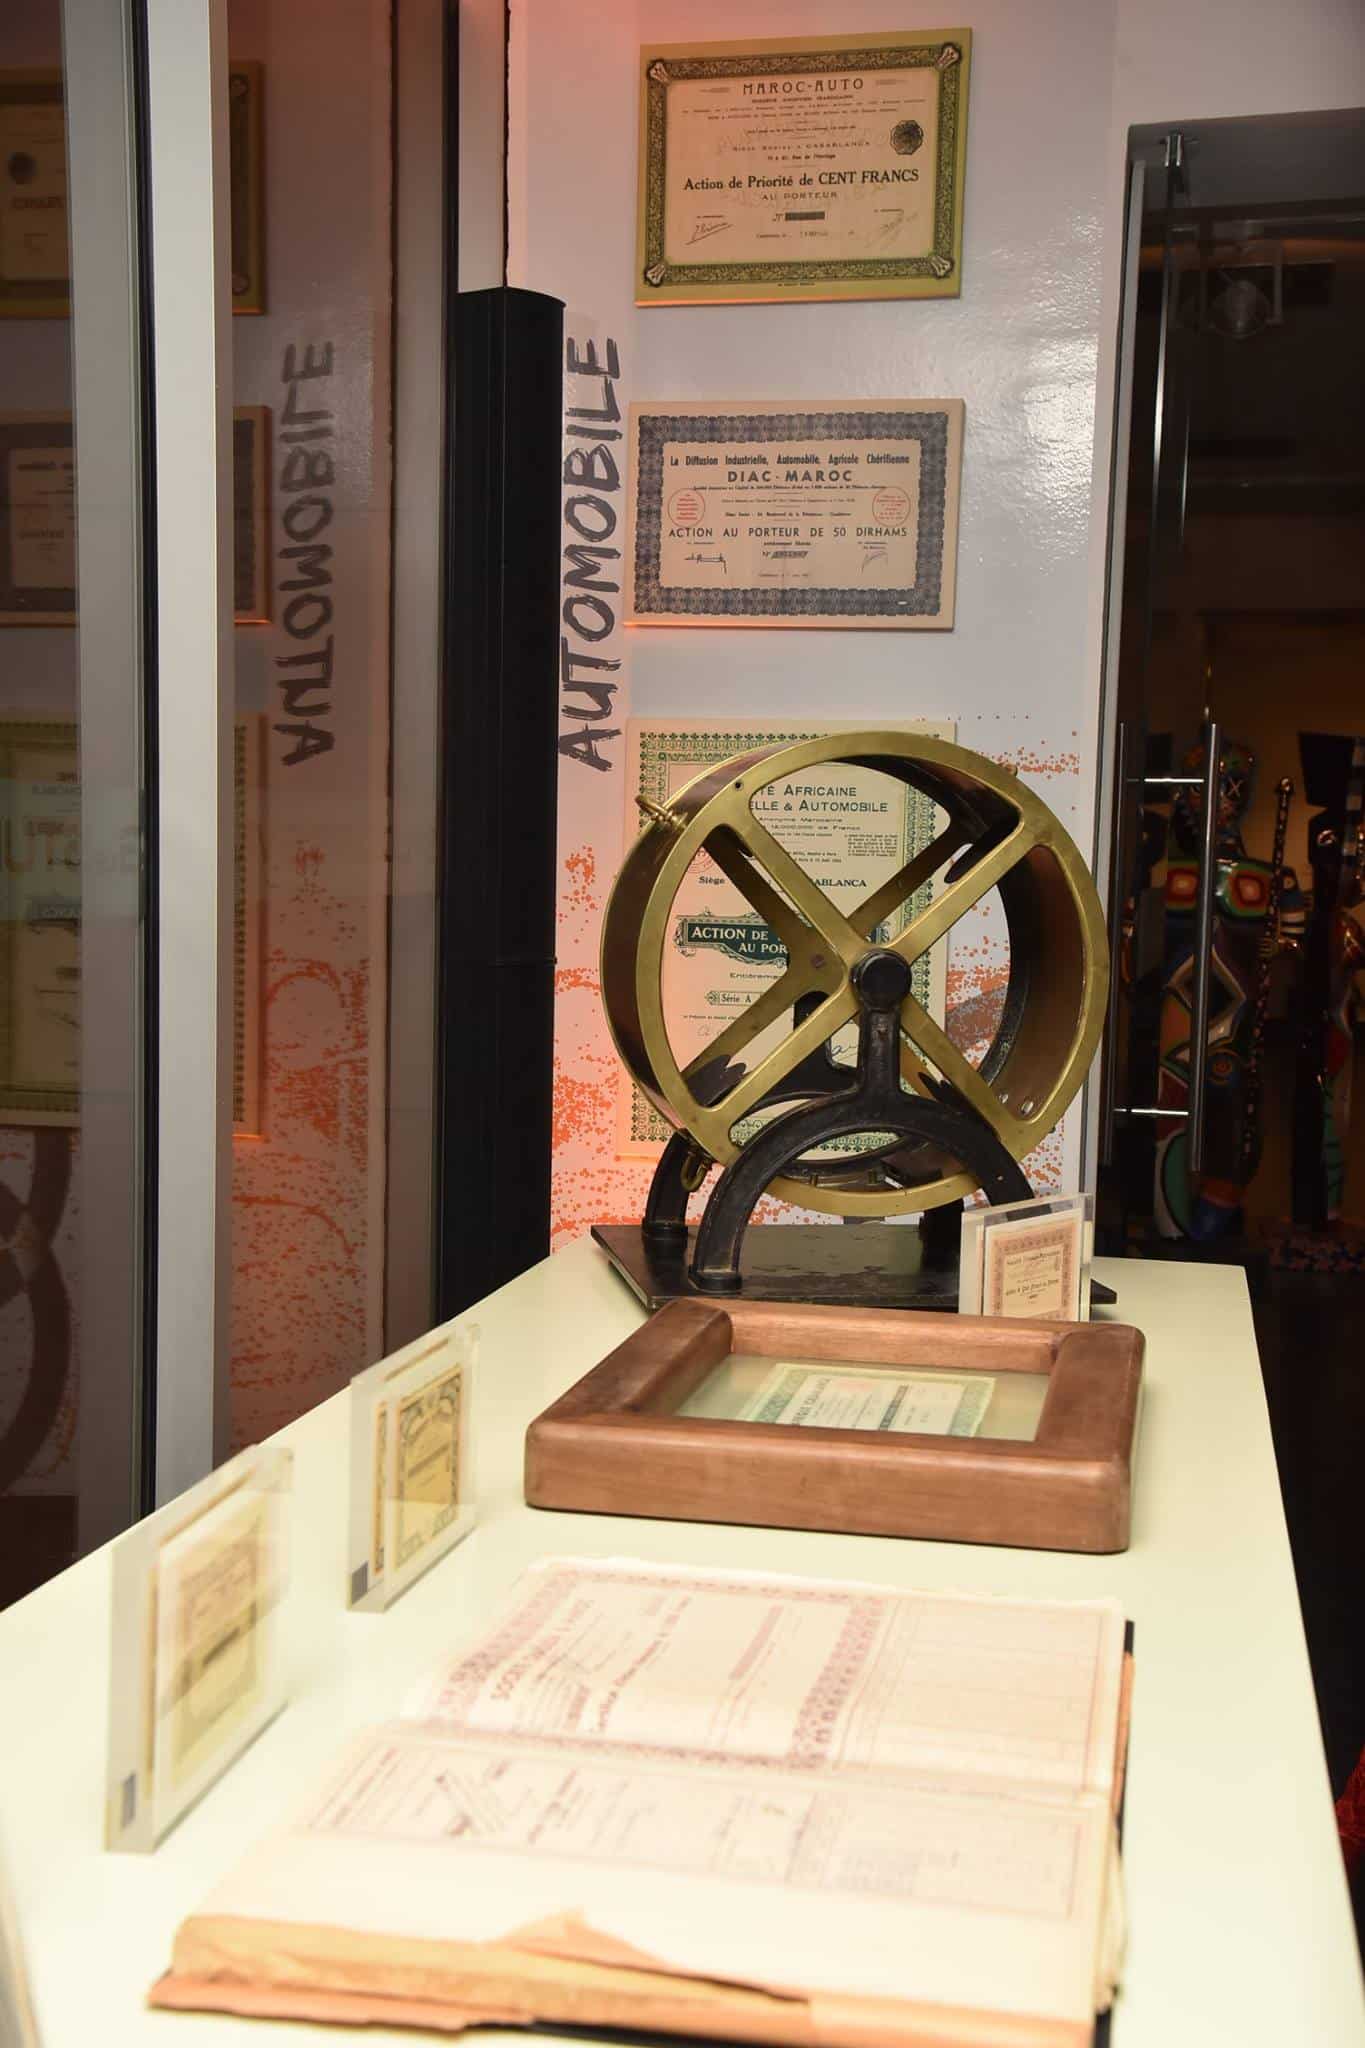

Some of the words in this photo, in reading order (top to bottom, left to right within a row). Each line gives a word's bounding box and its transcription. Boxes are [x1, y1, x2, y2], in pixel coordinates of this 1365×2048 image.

[743, 78, 864, 96] MAROC-AUTO
[684, 177, 724, 190] Action
[728, 176, 743, 189] de
[748, 174, 794, 188] Priorité
[799, 172, 814, 186] de
[818, 170, 857, 185] CENT
[861, 168, 920, 184] FRANCS
[670, 455, 679, 466] La
[685, 455, 719, 466] Diffusion
[828, 453, 859, 466] Agricole
[668, 527, 713, 538] ACTION
[723, 527, 738, 538] AU
[748, 527, 800, 537] PORTEUR
[810, 527, 825, 538] DE
[833, 527, 847, 538] 50
[855, 527, 908, 537] DIRHAMS
[558, 337, 623, 772] AUTOMOBILE
[784, 783, 857, 797] AFRICAINE
[783, 802, 793, 812] &
[799, 799, 889, 813] AUTOMOBILE
[698, 876, 725, 886] Siège
[814, 879, 867, 888] ABLANCA
[691, 926, 747, 940] ACTION
[751, 930, 769, 941] DE
[738, 942, 756, 953] AU
[761, 943, 788, 954] POR
